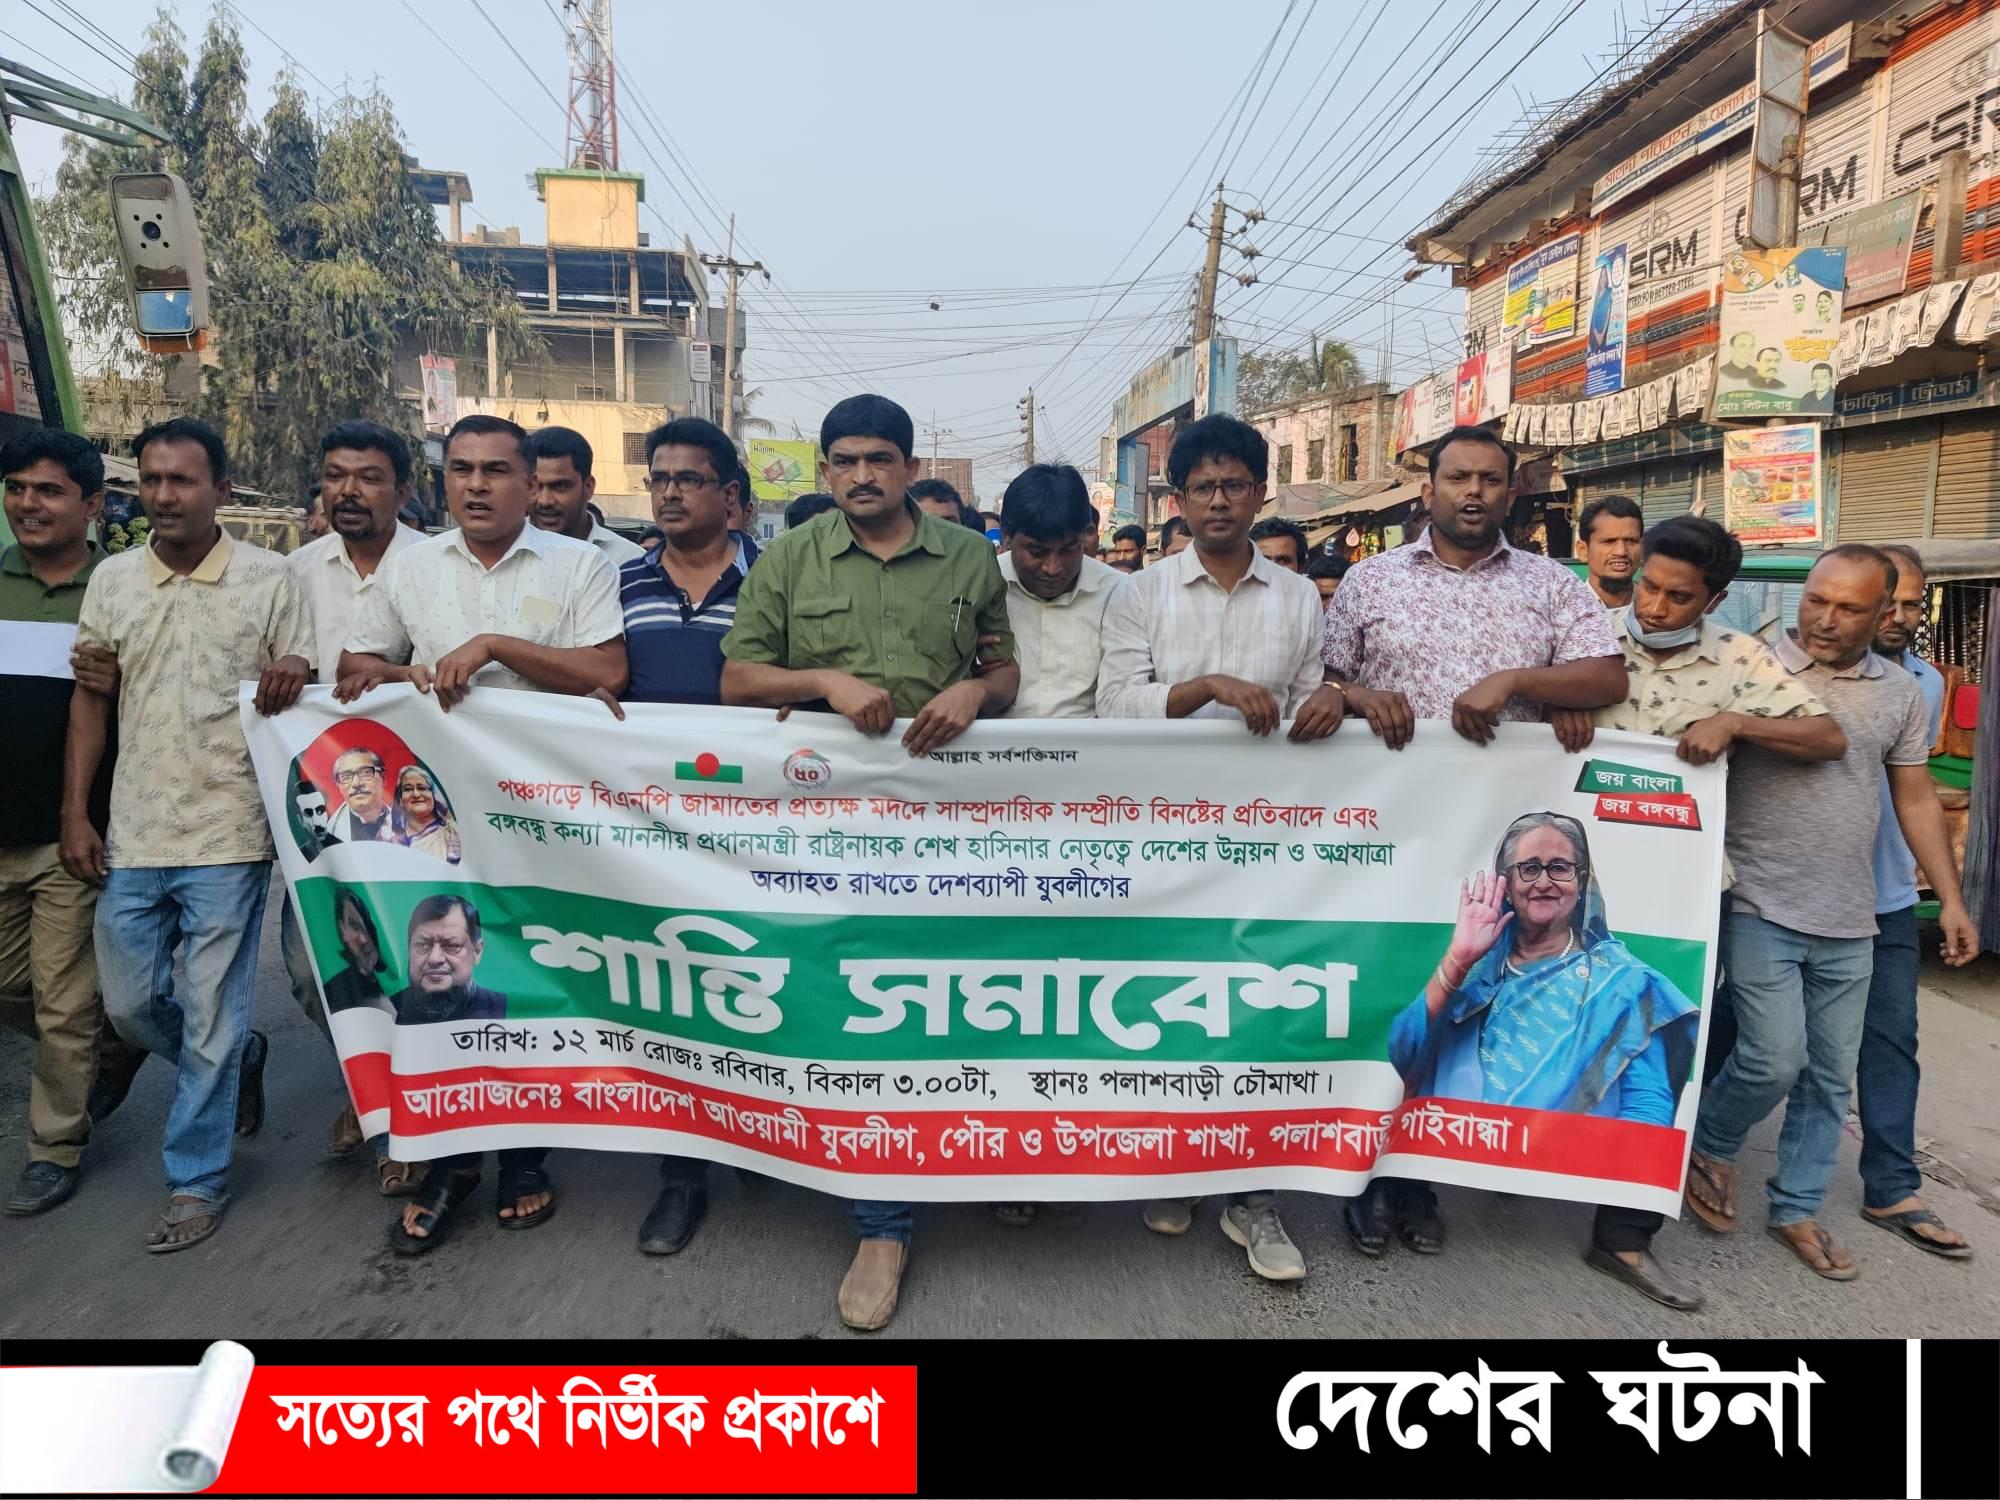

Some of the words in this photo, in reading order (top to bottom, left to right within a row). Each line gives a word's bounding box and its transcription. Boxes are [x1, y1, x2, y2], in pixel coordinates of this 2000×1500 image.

[1893, 86, 2000, 177] CSR
[1628, 229, 1698, 279] SRM
[987, 746, 1079, 763] সর্বশক্তিমান
[497, 778, 584, 811] পঞ্চগড়ে
[590, 780, 673, 816] বিএনপি
[680, 793, 781, 818] জামাতের
[788, 795, 862, 820] প্রত্যক্ষ
[869, 797, 929, 822] মদদে
[935, 794, 1057, 826] সাম্প্রদায়িক
[1062, 794, 1144, 827] সম্প্রীতি
[1149, 796, 1227, 826] বিনষ্টের
[1233, 797, 1326, 828] প্রতিবাদে
[1333, 804, 1380, 831] এবং
[1594, 770, 1627, 788] জয়
[1629, 773, 1677, 793] বাংলা
[1600, 797, 1632, 815] জয়
[1637, 800, 1693, 825] বঙ্গবন্ধু
[485, 811, 548, 846] বঙ্গবন্ধু
[551, 820, 604, 848] কন্যা
[610, 820, 689, 851] মাননীয়
[696, 825, 801, 858] প্রধানমন্ত্রী
[807, 827, 906, 861] রাষ্ট্রনায়ক
[914, 833, 960, 860] শেখ
[965, 829, 1050, 861] হাসিনার
[1060, 838, 1134, 872] নেতৃত্বে
[1141, 837, 1209, 863] দেশের
[1214, 832, 1281, 869] উন্নয়ন
[1287, 841, 1305, 863] ও
[1312, 841, 1397, 867] অগ্রযাত্রা
[750, 869, 841, 896] অব্যাহত
[849, 871, 921, 898] রাখতে
[926, 866, 1029, 899] দেশব্যাপী
[1034, 866, 1132, 905] যুবলীগের
[520, 913, 791, 1034] শান্তি
[839, 957, 1358, 1051] সমাবেশ
[551, 1028, 588, 1055] ১২
[595, 1028, 636, 1054] মার্চ
[709, 1050, 795, 1096] রবিবার,
[803, 1062, 885, 1097] বিকাল
[893, 1063, 998, 1101] ৩.০০টা,
[1099, 1064, 1225, 1102] পলাশবাড়ী
[571, 1078, 696, 1121] বাংলাদেশ
[701, 1098, 812, 1151] আওয়ামী
[817, 1114, 925, 1167] যুবলীগ,
[939, 1113, 1010, 1160] পৌর
[1018, 1126, 1043, 1158] ও
[1052, 1116, 1178, 1161] উপজেলা
[1184, 1122, 1255, 1161] শাখা,
